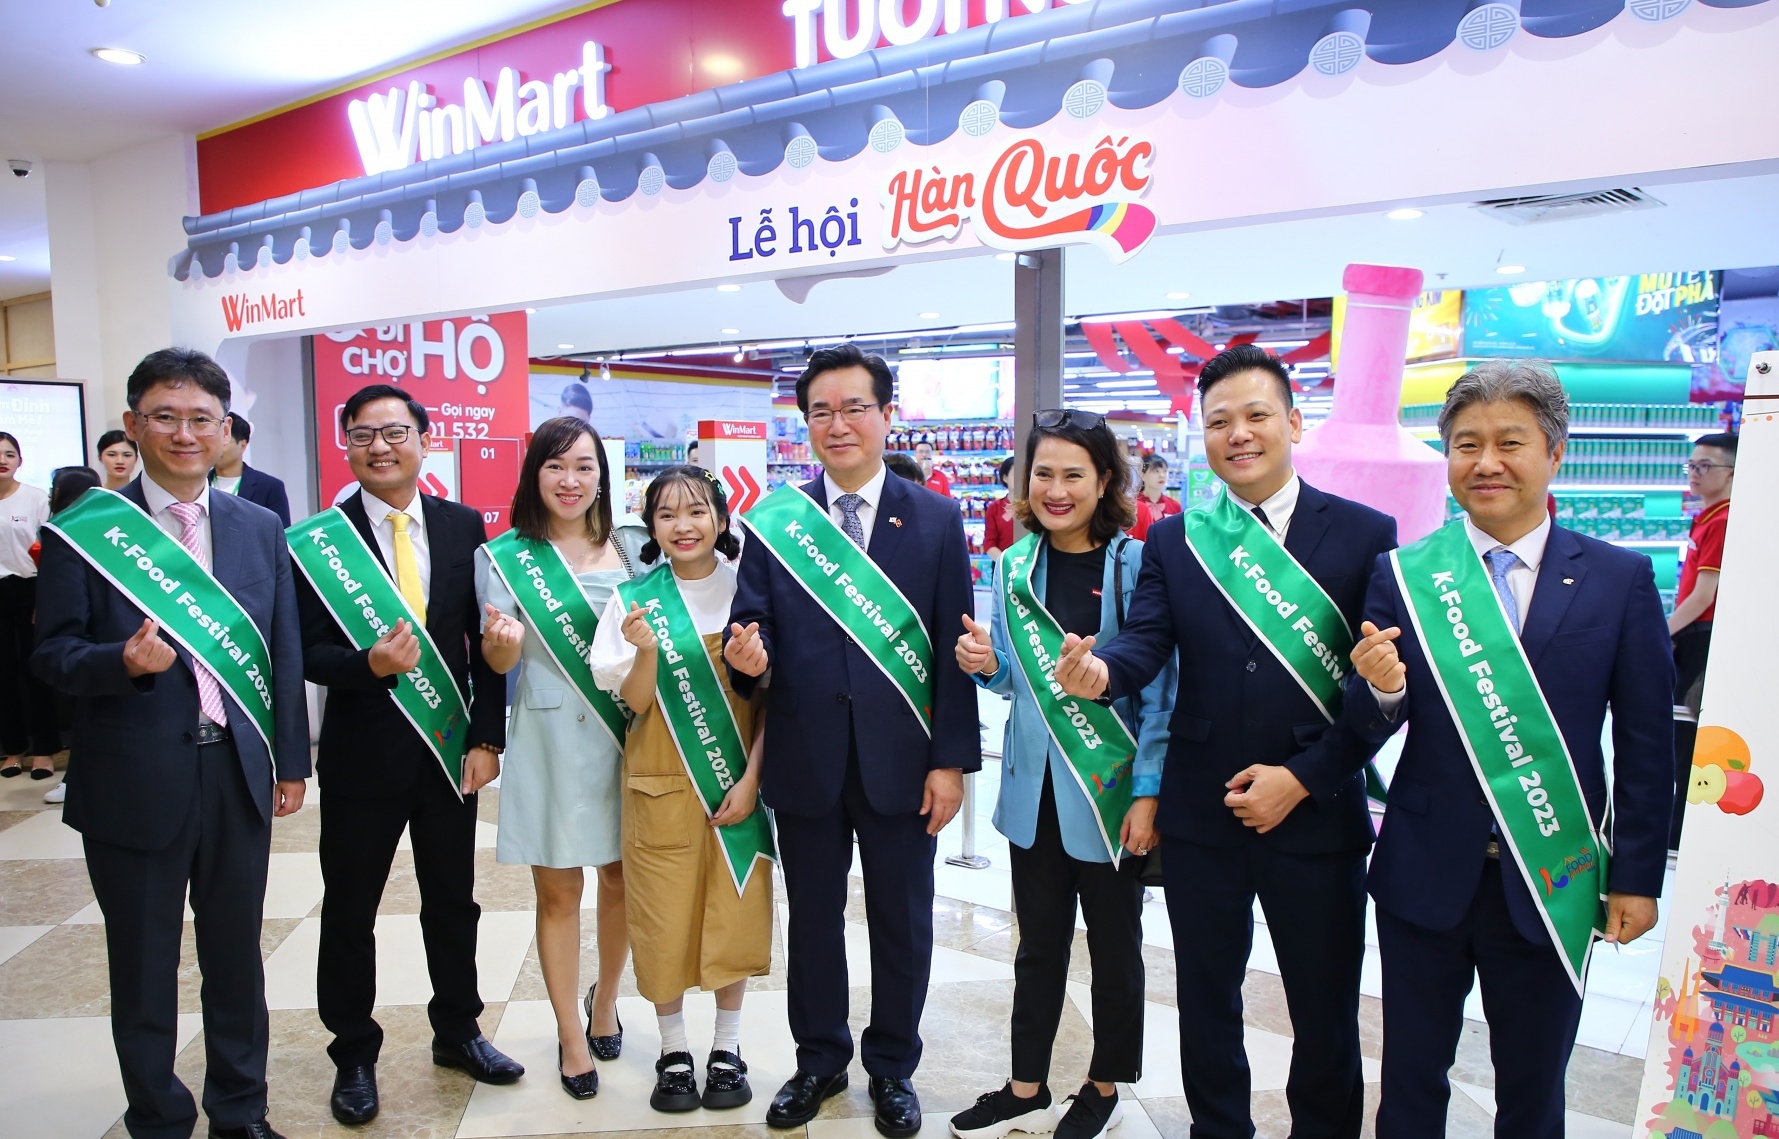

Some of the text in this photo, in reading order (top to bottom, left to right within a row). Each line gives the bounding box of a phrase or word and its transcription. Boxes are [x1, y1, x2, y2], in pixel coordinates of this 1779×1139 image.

[348, 41, 609, 176] WinMart
[729, 135, 1153, 261] Lễ hội Hàn Quốc
[221, 289, 305, 332] WinMart
[342, 315, 505, 395] CHỢ HỘ
[441, 403, 495, 420] Gọi ngay
[452, 421, 489, 439] 532
[722, 422, 757, 436] WinMart
[480, 447, 495, 459] 01
[484, 512, 499, 523] 07
[103, 525, 272, 711] K-Food Festival 2023
[308, 527, 443, 710] K-Food Fest 2023
[515, 549, 563, 613] K-Food
[784, 519, 928, 684] K-Food Festival 2023
[1228, 545, 1344, 686] K-Food Festiv
[644, 598, 735, 791] K-Food Festival 2023
[1062, 700, 1103, 750] 2023
[1430, 570, 1561, 838] K-Food Festival 2023
